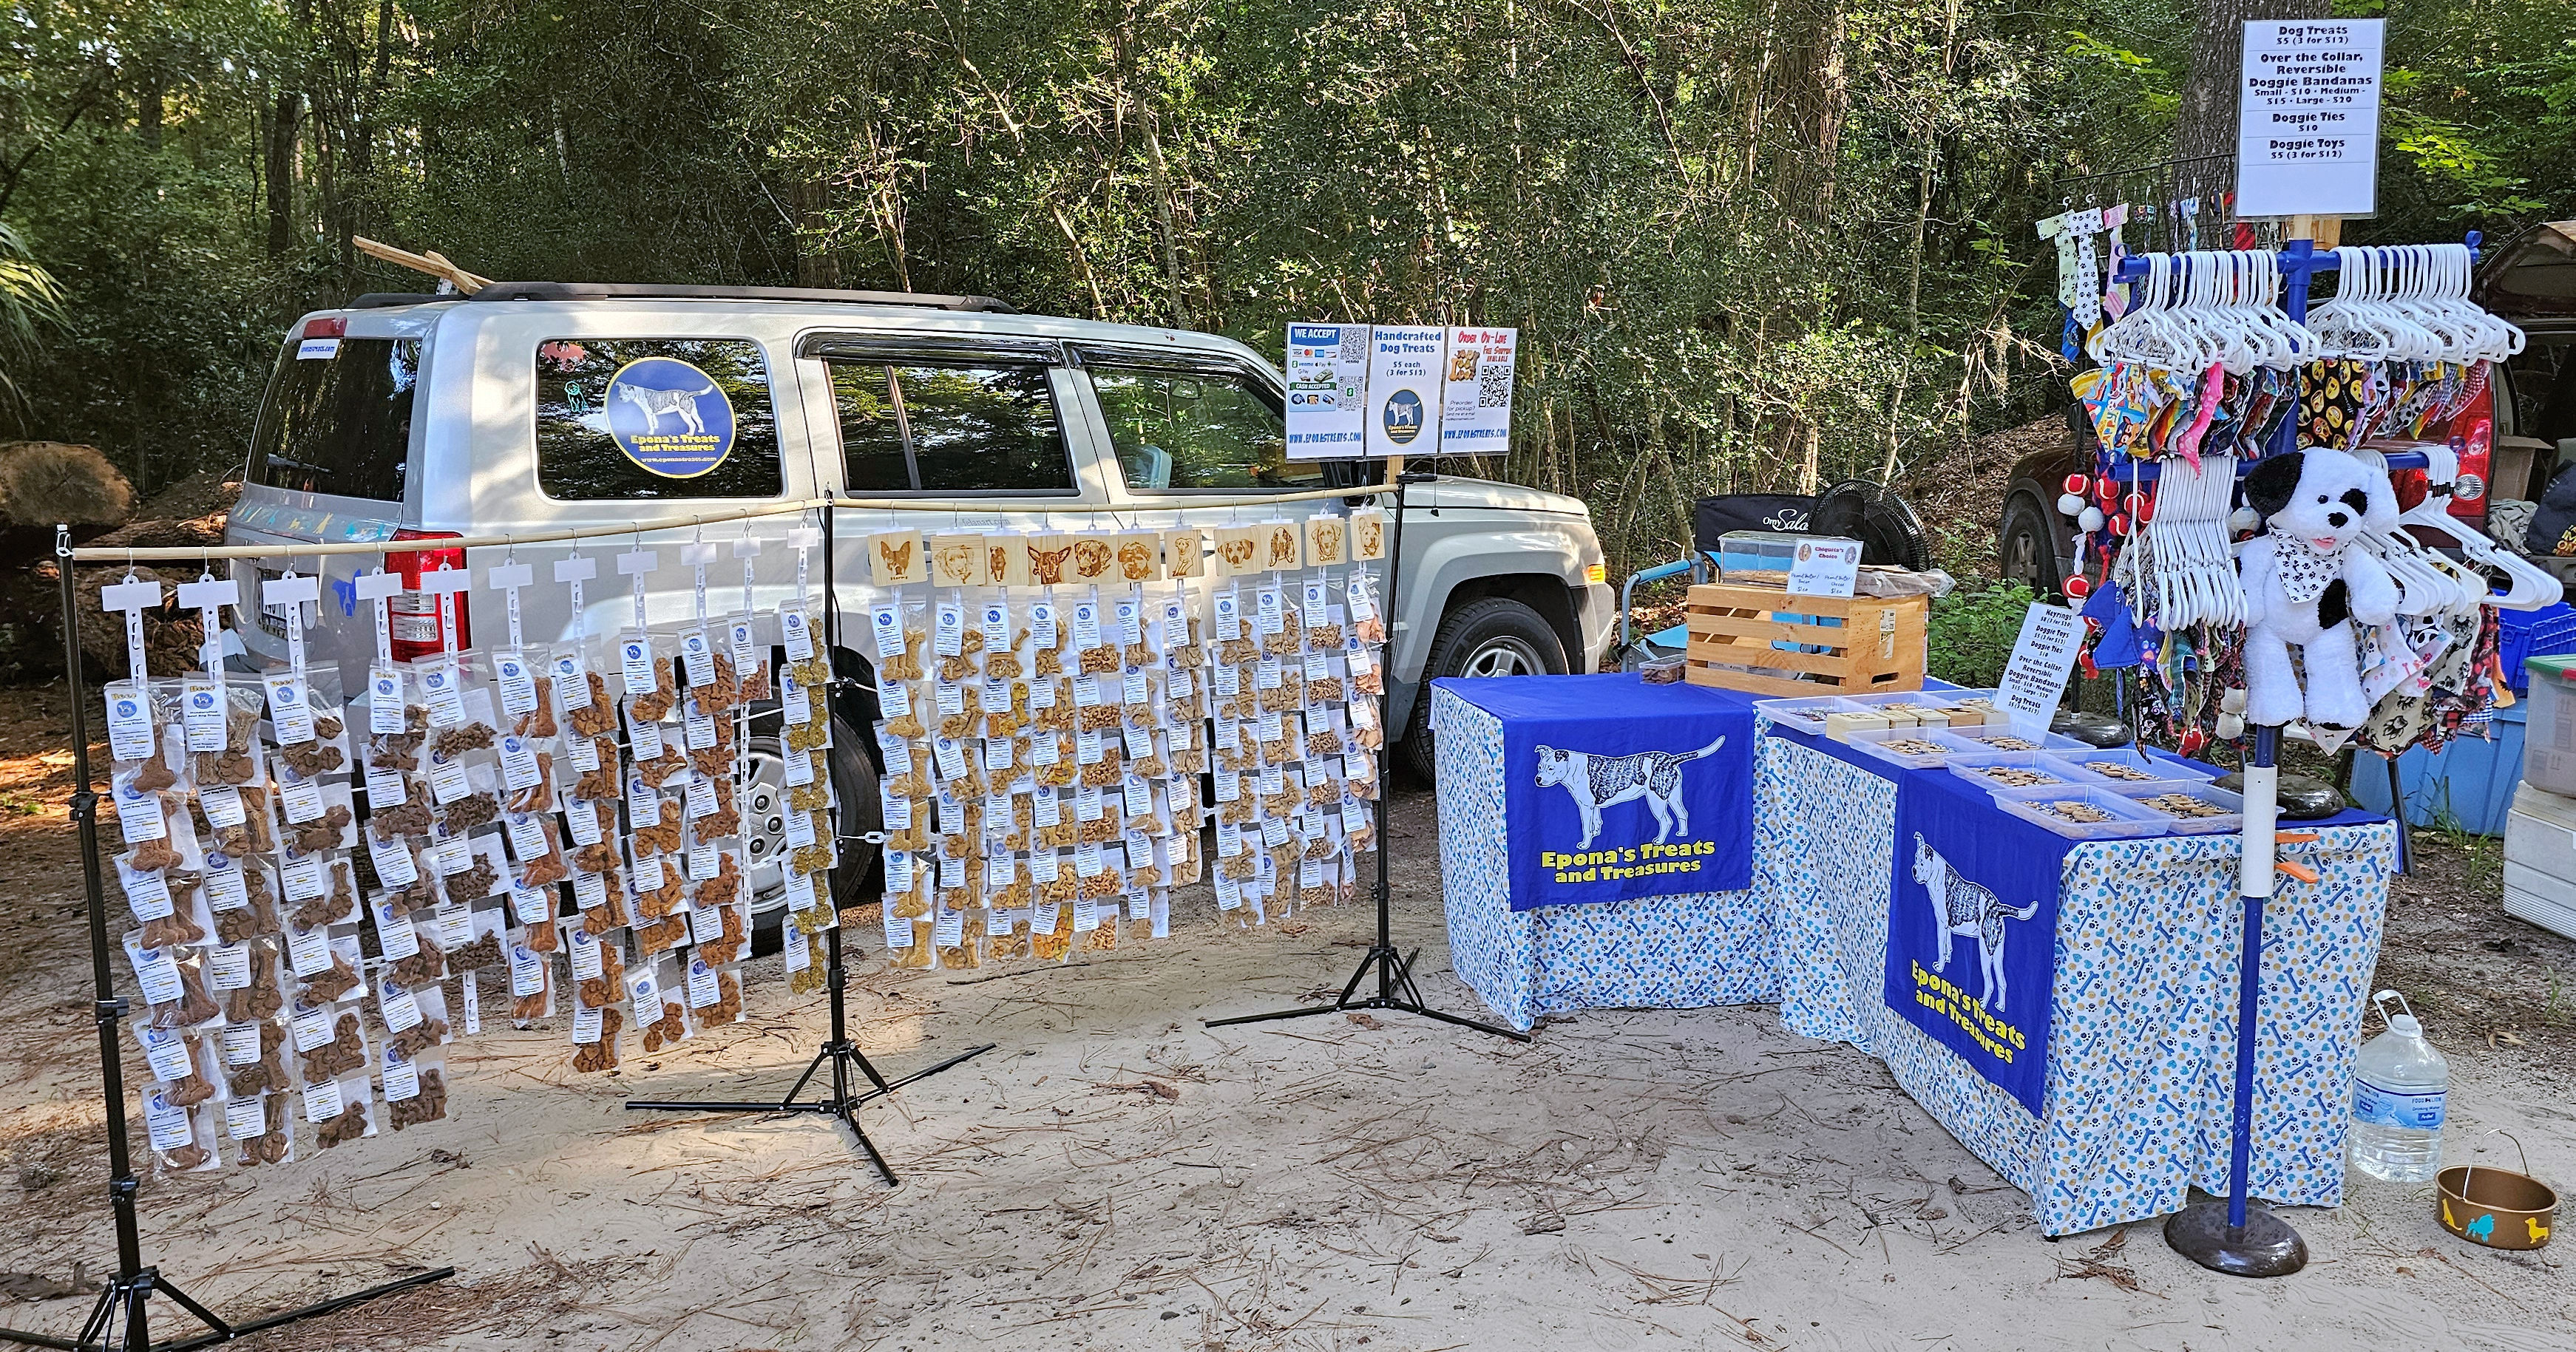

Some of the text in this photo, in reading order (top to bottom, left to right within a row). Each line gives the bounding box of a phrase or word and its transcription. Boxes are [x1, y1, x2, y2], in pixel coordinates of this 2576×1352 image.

[2280, 26, 2348, 36] Dog Treats
[2293, 37, 2302, 45] (3
[2261, 52, 2363, 62] Over the Collar,
[2277, 65, 2345, 74] Reversible
[2249, 77, 2372, 88] Doggie Bandanas
[2297, 97, 2323, 105] Large
[2273, 112, 2345, 123] Doggie Ties
[2270, 139, 2345, 150] Doggie Toys
[1295, 328, 1336, 338] WE ACCEPT
[1375, 331, 1441, 342] Handcrafted
[1380, 344, 1434, 354] Dog Treats
[631, 435, 720, 445] Epona's Treats
[2046, 609, 2072, 620] Keyrings
[2036, 625, 2070, 638] Doggie Toys
[2031, 641, 2063, 653] Doggie Ties
[2022, 665, 2052, 678] Reversible
[2044, 662, 2062, 672] Collar,
[270, 679, 294, 687] Beef
[2009, 670, 2061, 689] Doggie Bandanas
[2011, 695, 2041, 708] Dog Treats
[1542, 840, 1715, 869] Epona's Treats
[1555, 859, 1701, 883] and Treasures
[1911, 959, 2026, 1050] Epona's Treats
[1916, 988, 2013, 1064] and Treasures
